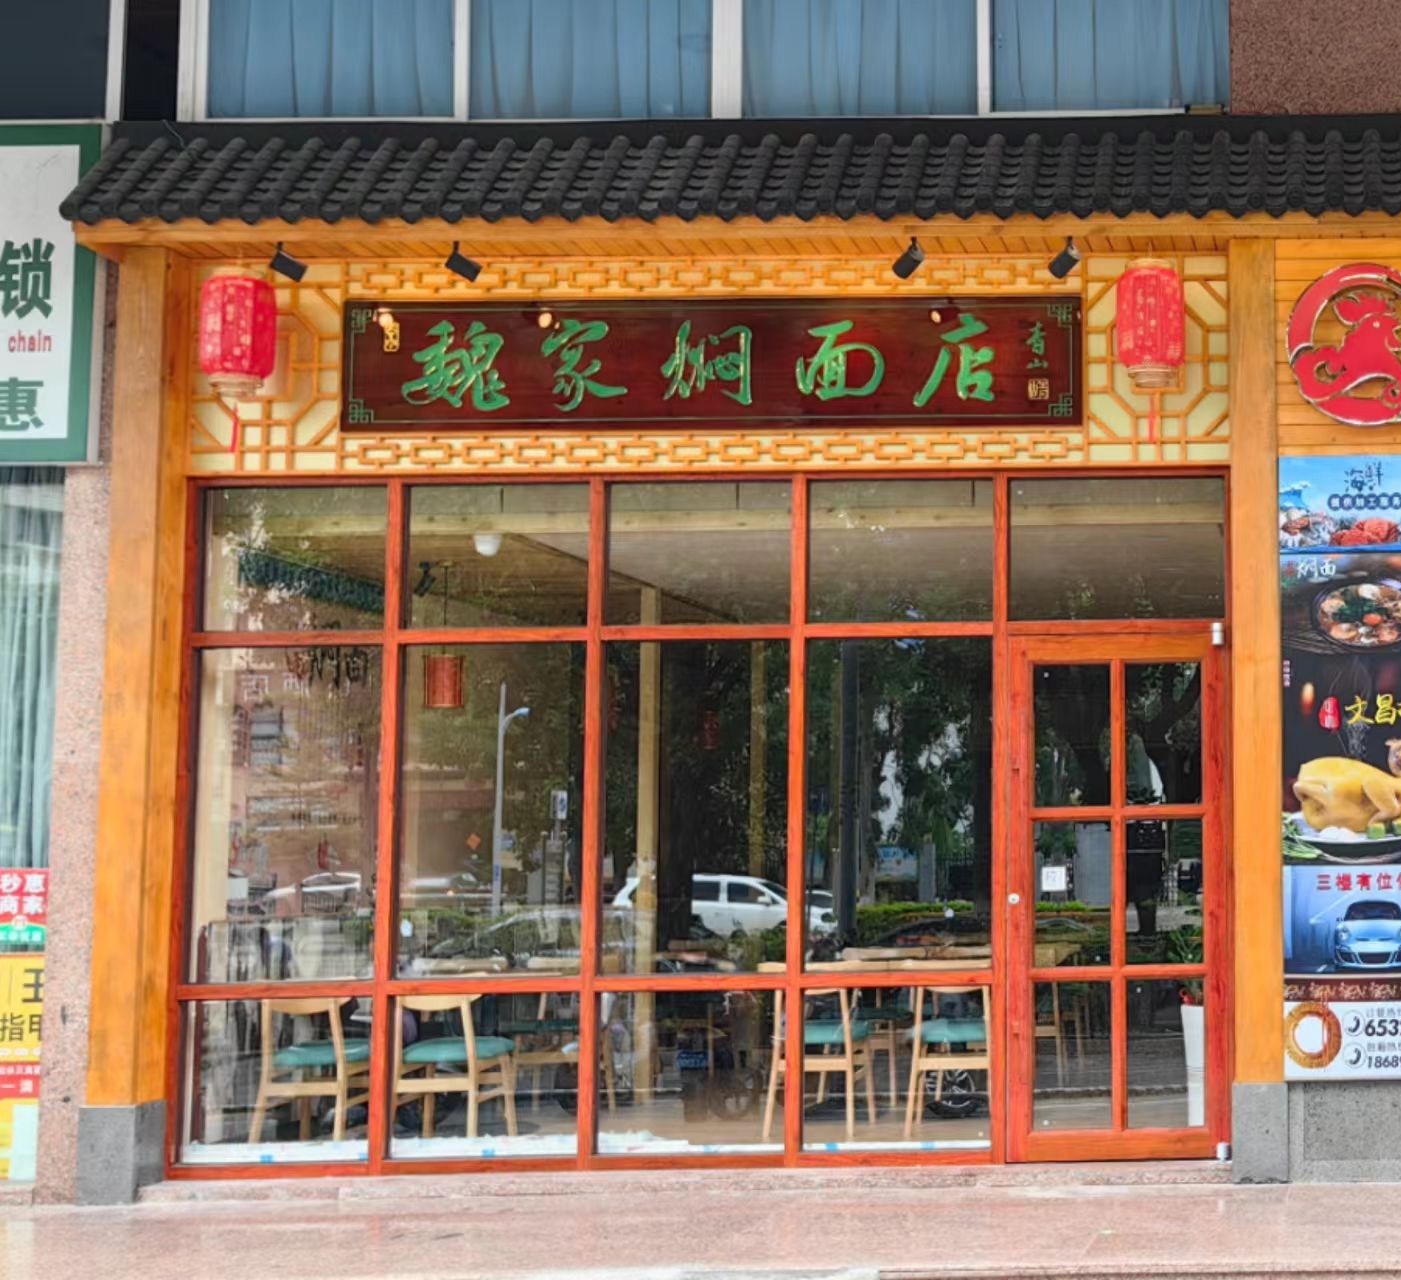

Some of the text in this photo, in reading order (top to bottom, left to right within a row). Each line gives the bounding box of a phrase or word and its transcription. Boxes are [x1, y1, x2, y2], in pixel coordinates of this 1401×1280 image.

[0, 238, 55, 319] 锁
[8, 331, 51, 352] chain
[402, 313, 996, 411] 魏家焖面店
